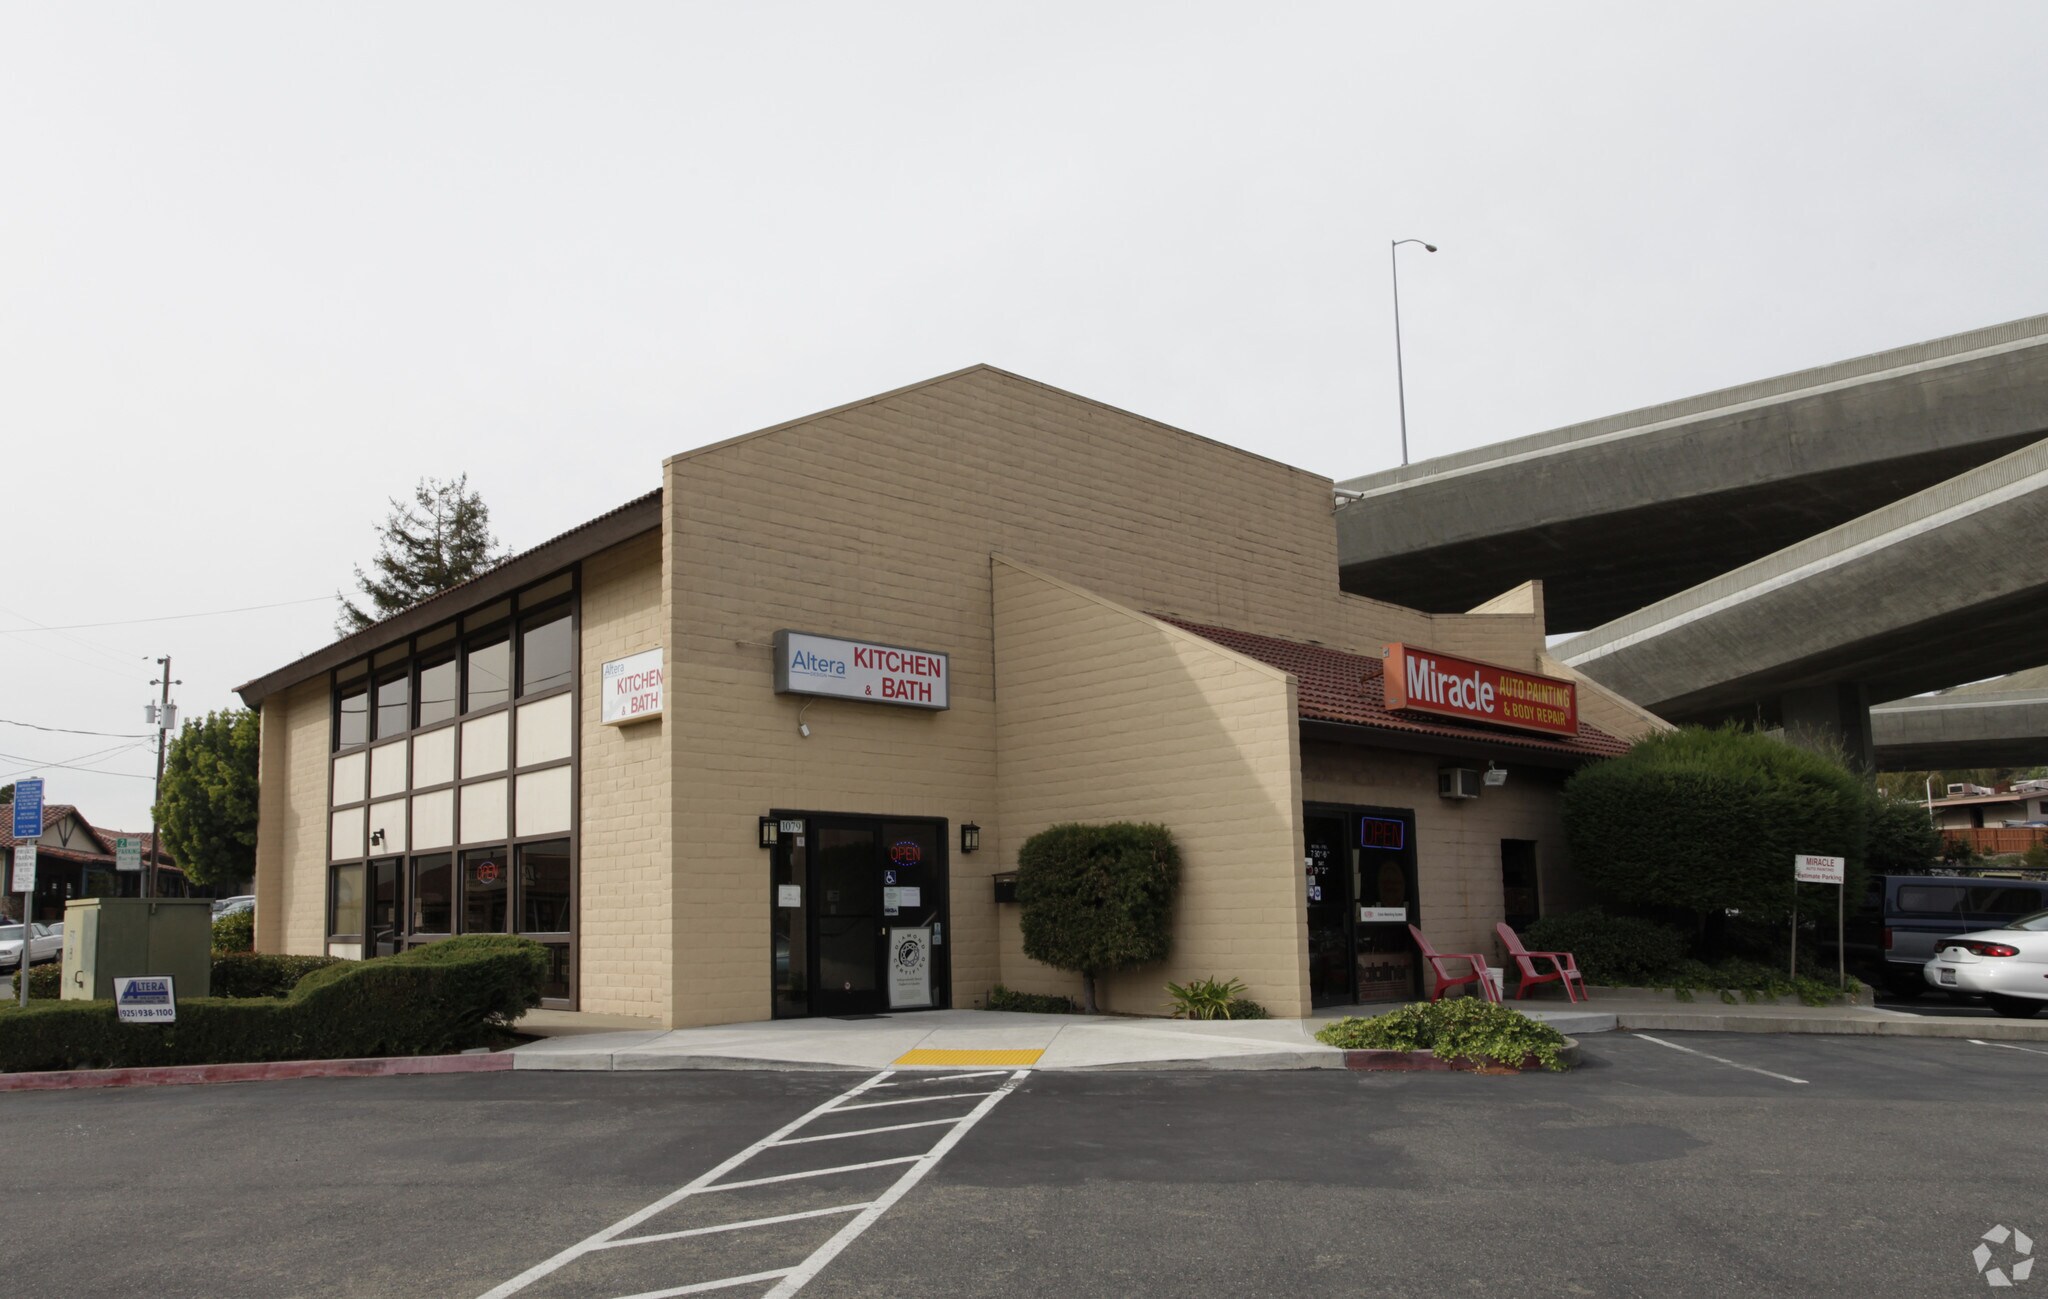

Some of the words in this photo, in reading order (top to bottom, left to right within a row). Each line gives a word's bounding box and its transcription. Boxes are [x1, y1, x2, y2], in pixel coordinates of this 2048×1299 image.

[605, 663, 625, 676] Altera
[791, 650, 845, 675] Altera
[854, 646, 941, 678] KITCHEN
[865, 685, 872, 696] &
[882, 677, 932, 702] BATH
[1406, 655, 1495, 713] Miracle
[1499, 676, 1524, 699] AUTO
[1526, 681, 1570, 708] PAINTING
[621, 706, 626, 716] &
[631, 691, 658, 714] BATH
[1503, 701, 1511, 717] &
[1512, 705, 1535, 721] BODY
[1537, 708, 1567, 726] REPAIR
[781, 821, 801, 832] 1079
[1364, 820, 1401, 847] OPEN
[891, 846, 921, 861] OPEN
[1806, 857, 1835, 867] MIRACLE
[477, 865, 499, 880] OPEN
[1822, 873, 1842, 882] Parking
[894, 933, 926, 950] DIAMOND
[894, 957, 926, 975] CERTIFIED
[123, 981, 166, 999] ALTERA
